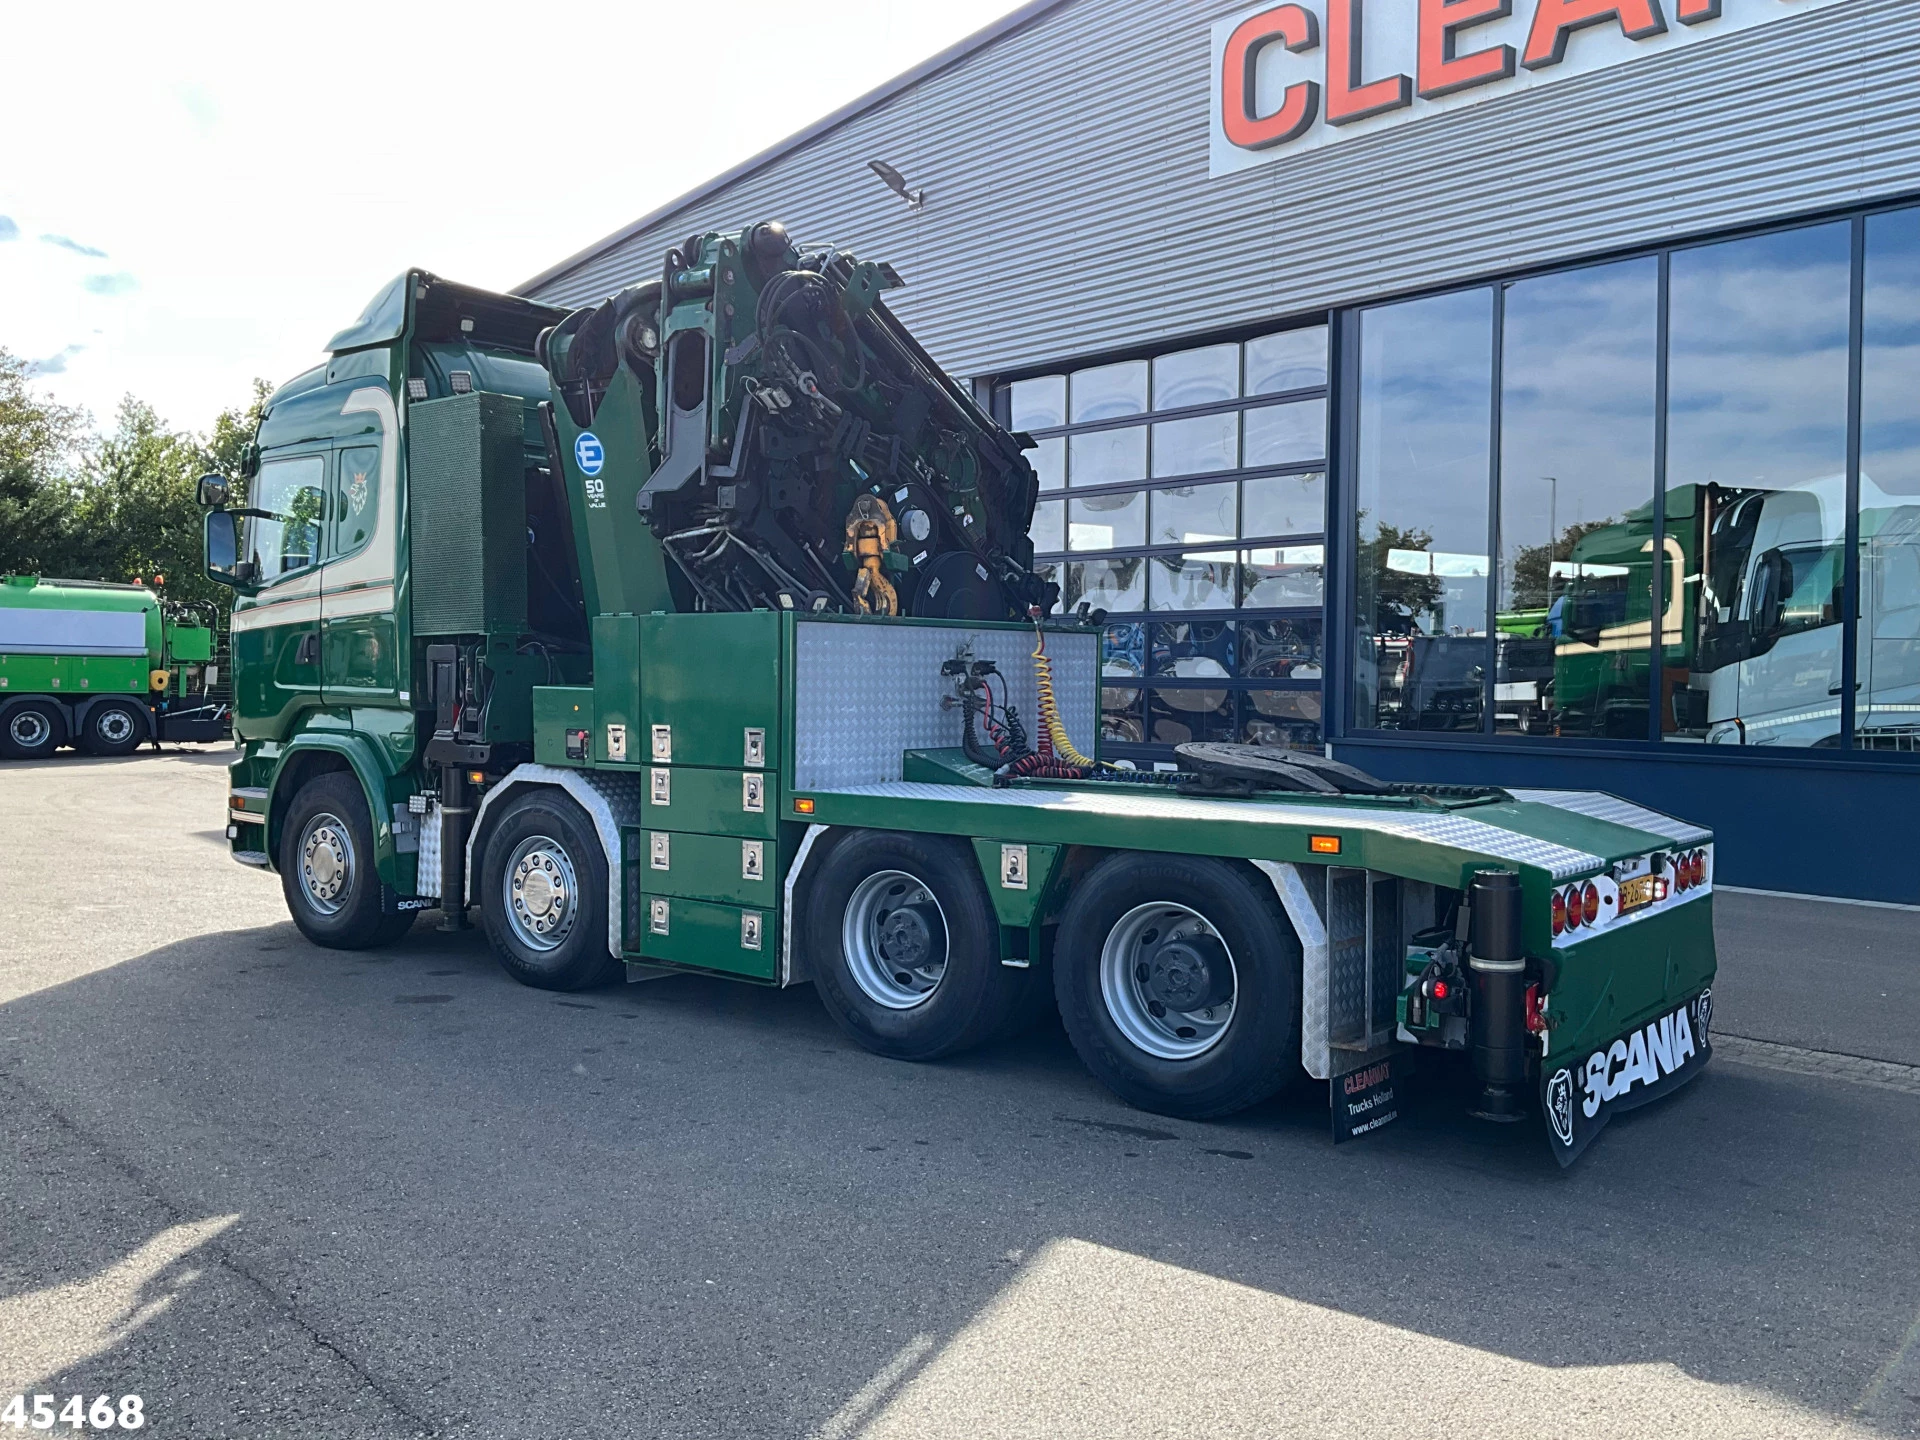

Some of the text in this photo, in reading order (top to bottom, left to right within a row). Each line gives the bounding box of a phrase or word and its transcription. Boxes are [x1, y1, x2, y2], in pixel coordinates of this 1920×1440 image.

[1222, 0, 1722, 151] CLE
[585, 478, 604, 494] 50
[1582, 1006, 1695, 1118] SCANIA
[1348, 1087, 1394, 1116] Trucks Holland
